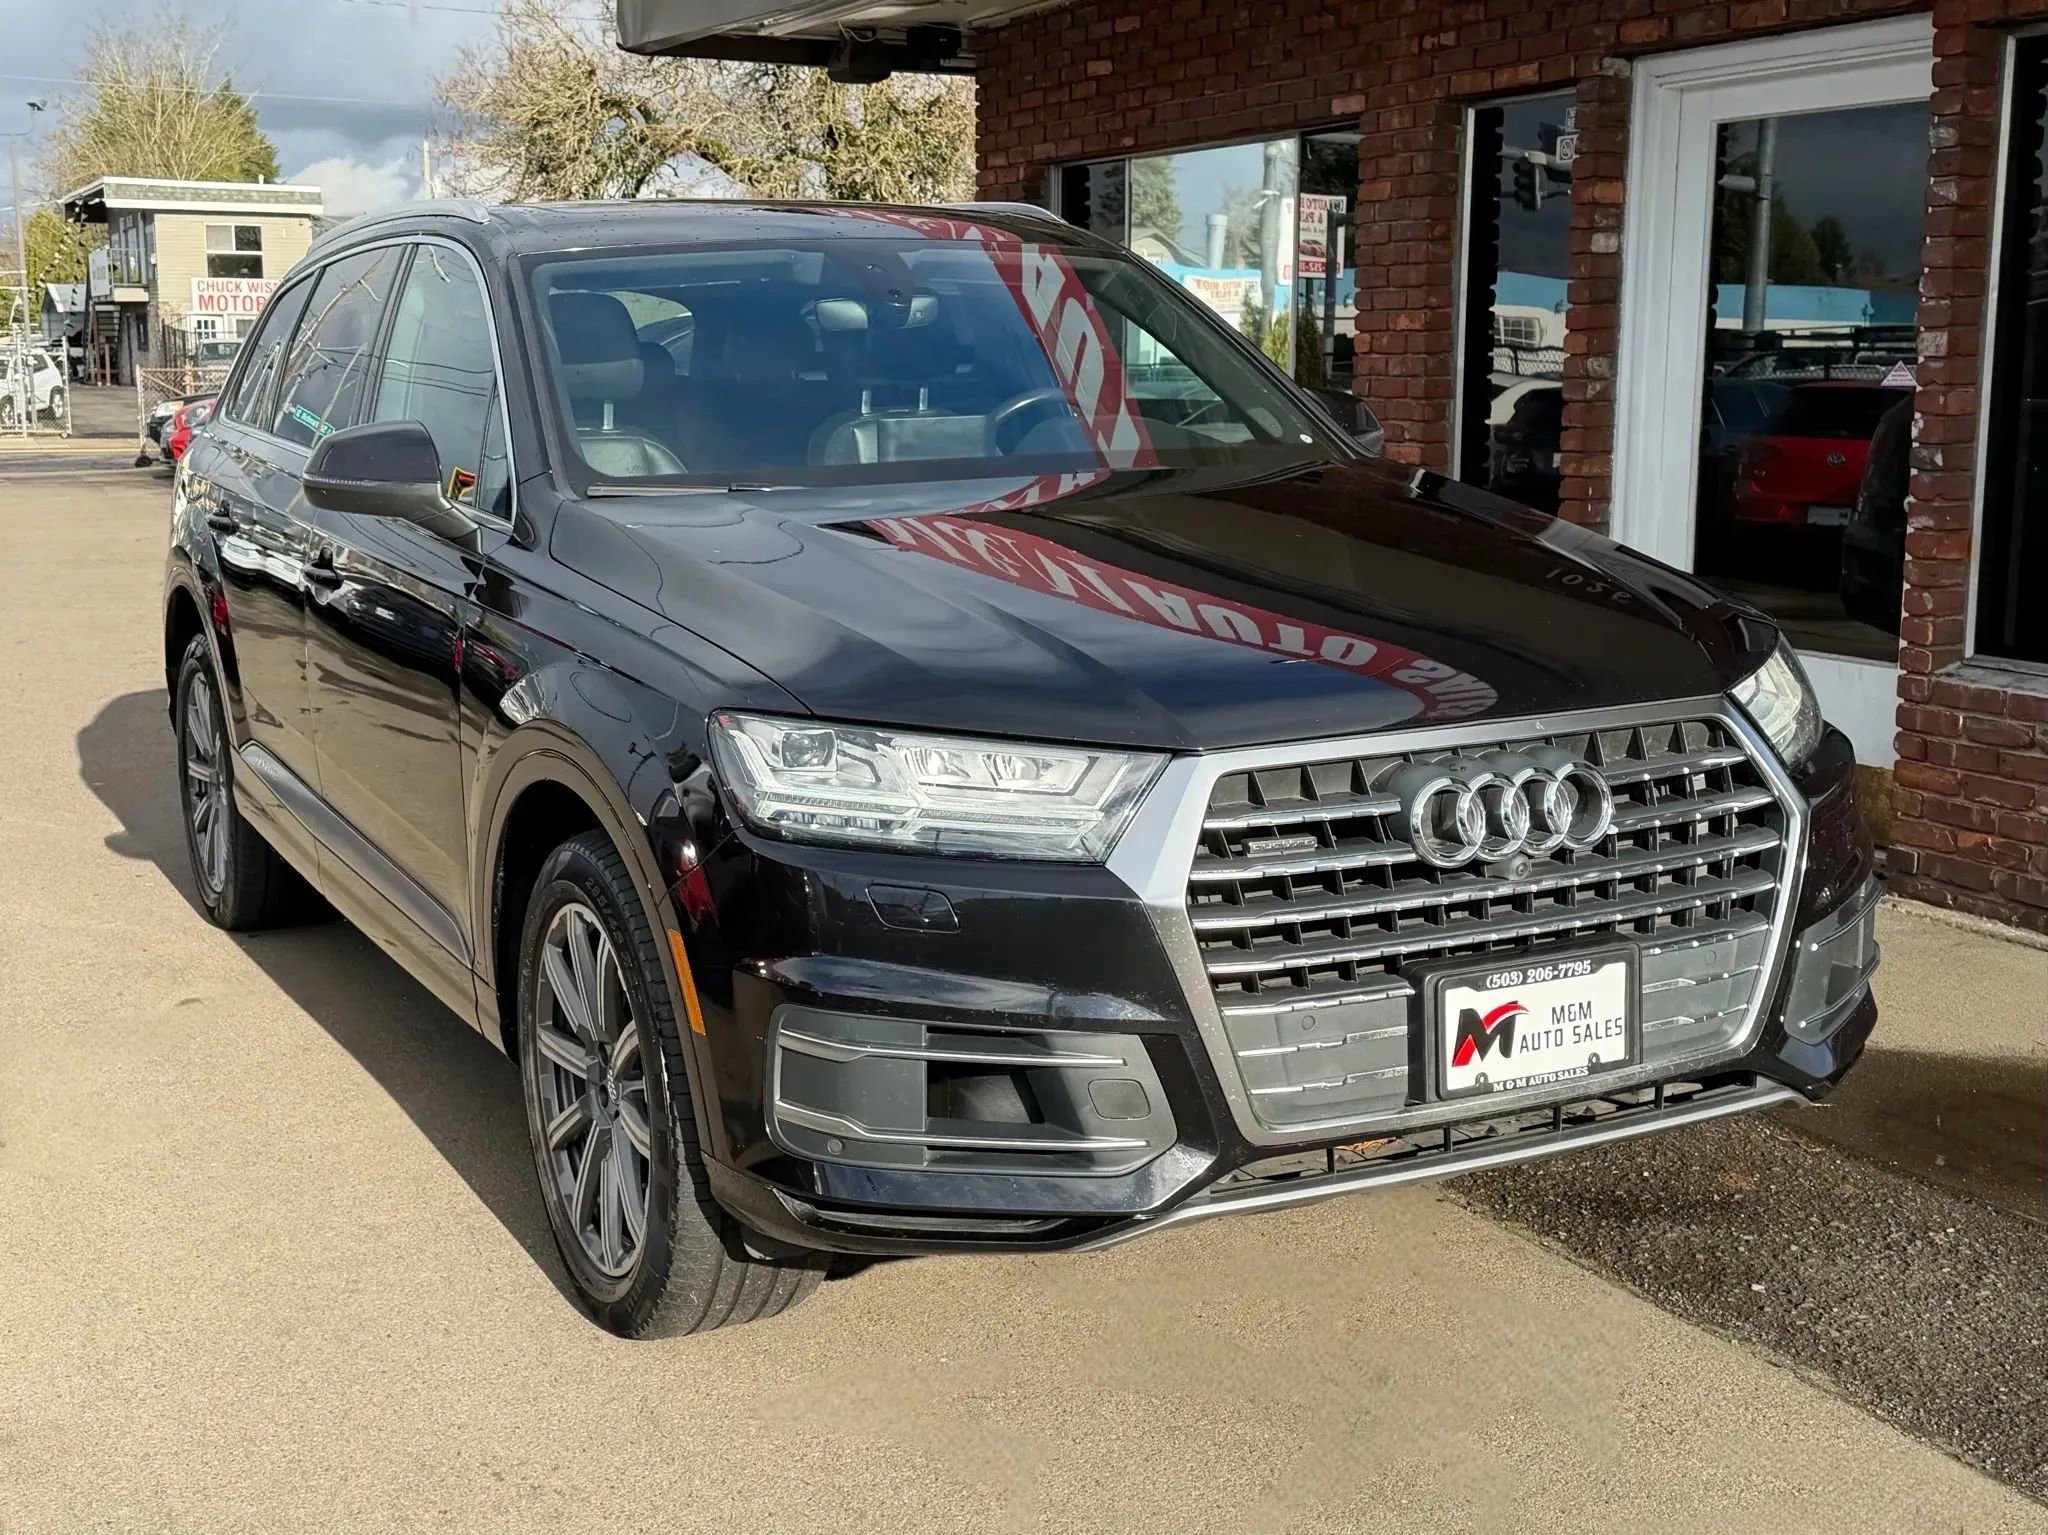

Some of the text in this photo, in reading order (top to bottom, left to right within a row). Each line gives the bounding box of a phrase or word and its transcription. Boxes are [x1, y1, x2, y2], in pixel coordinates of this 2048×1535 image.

[197, 280, 277, 294] CHUCK WIS
[1486, 960, 1592, 990] (503) 206-7795
[1551, 1001, 1592, 1026] M&M
[1519, 1017, 1623, 1054] AUTO SALES
[1528, 1072, 1557, 1086] AUTO
[1556, 1066, 1589, 1083] SALES
